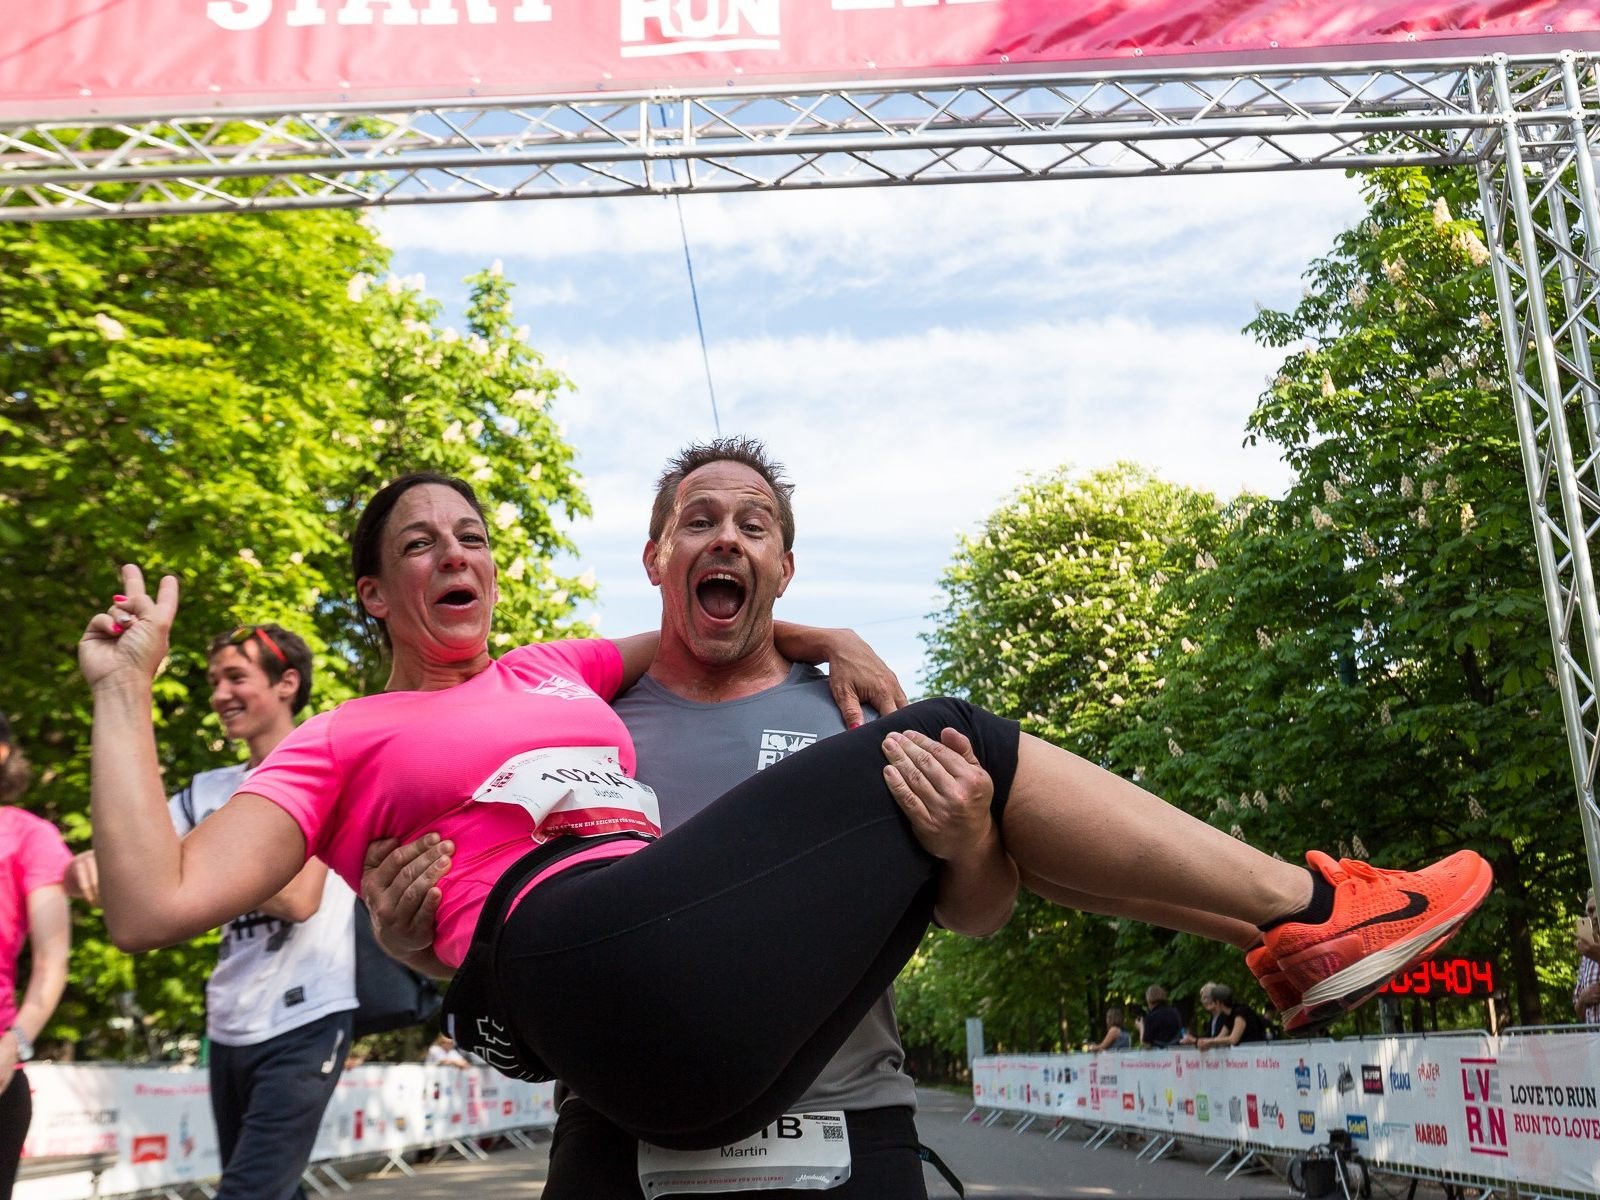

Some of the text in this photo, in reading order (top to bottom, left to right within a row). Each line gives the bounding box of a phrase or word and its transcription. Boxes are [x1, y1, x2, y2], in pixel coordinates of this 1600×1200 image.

[1510, 1085, 1597, 1108] LOVE TO RUN
[1415, 1122, 1448, 1147] HARIBO
[1513, 1113, 1600, 1140] RUN TO LOVE
[720, 1145, 768, 1158] Martin
